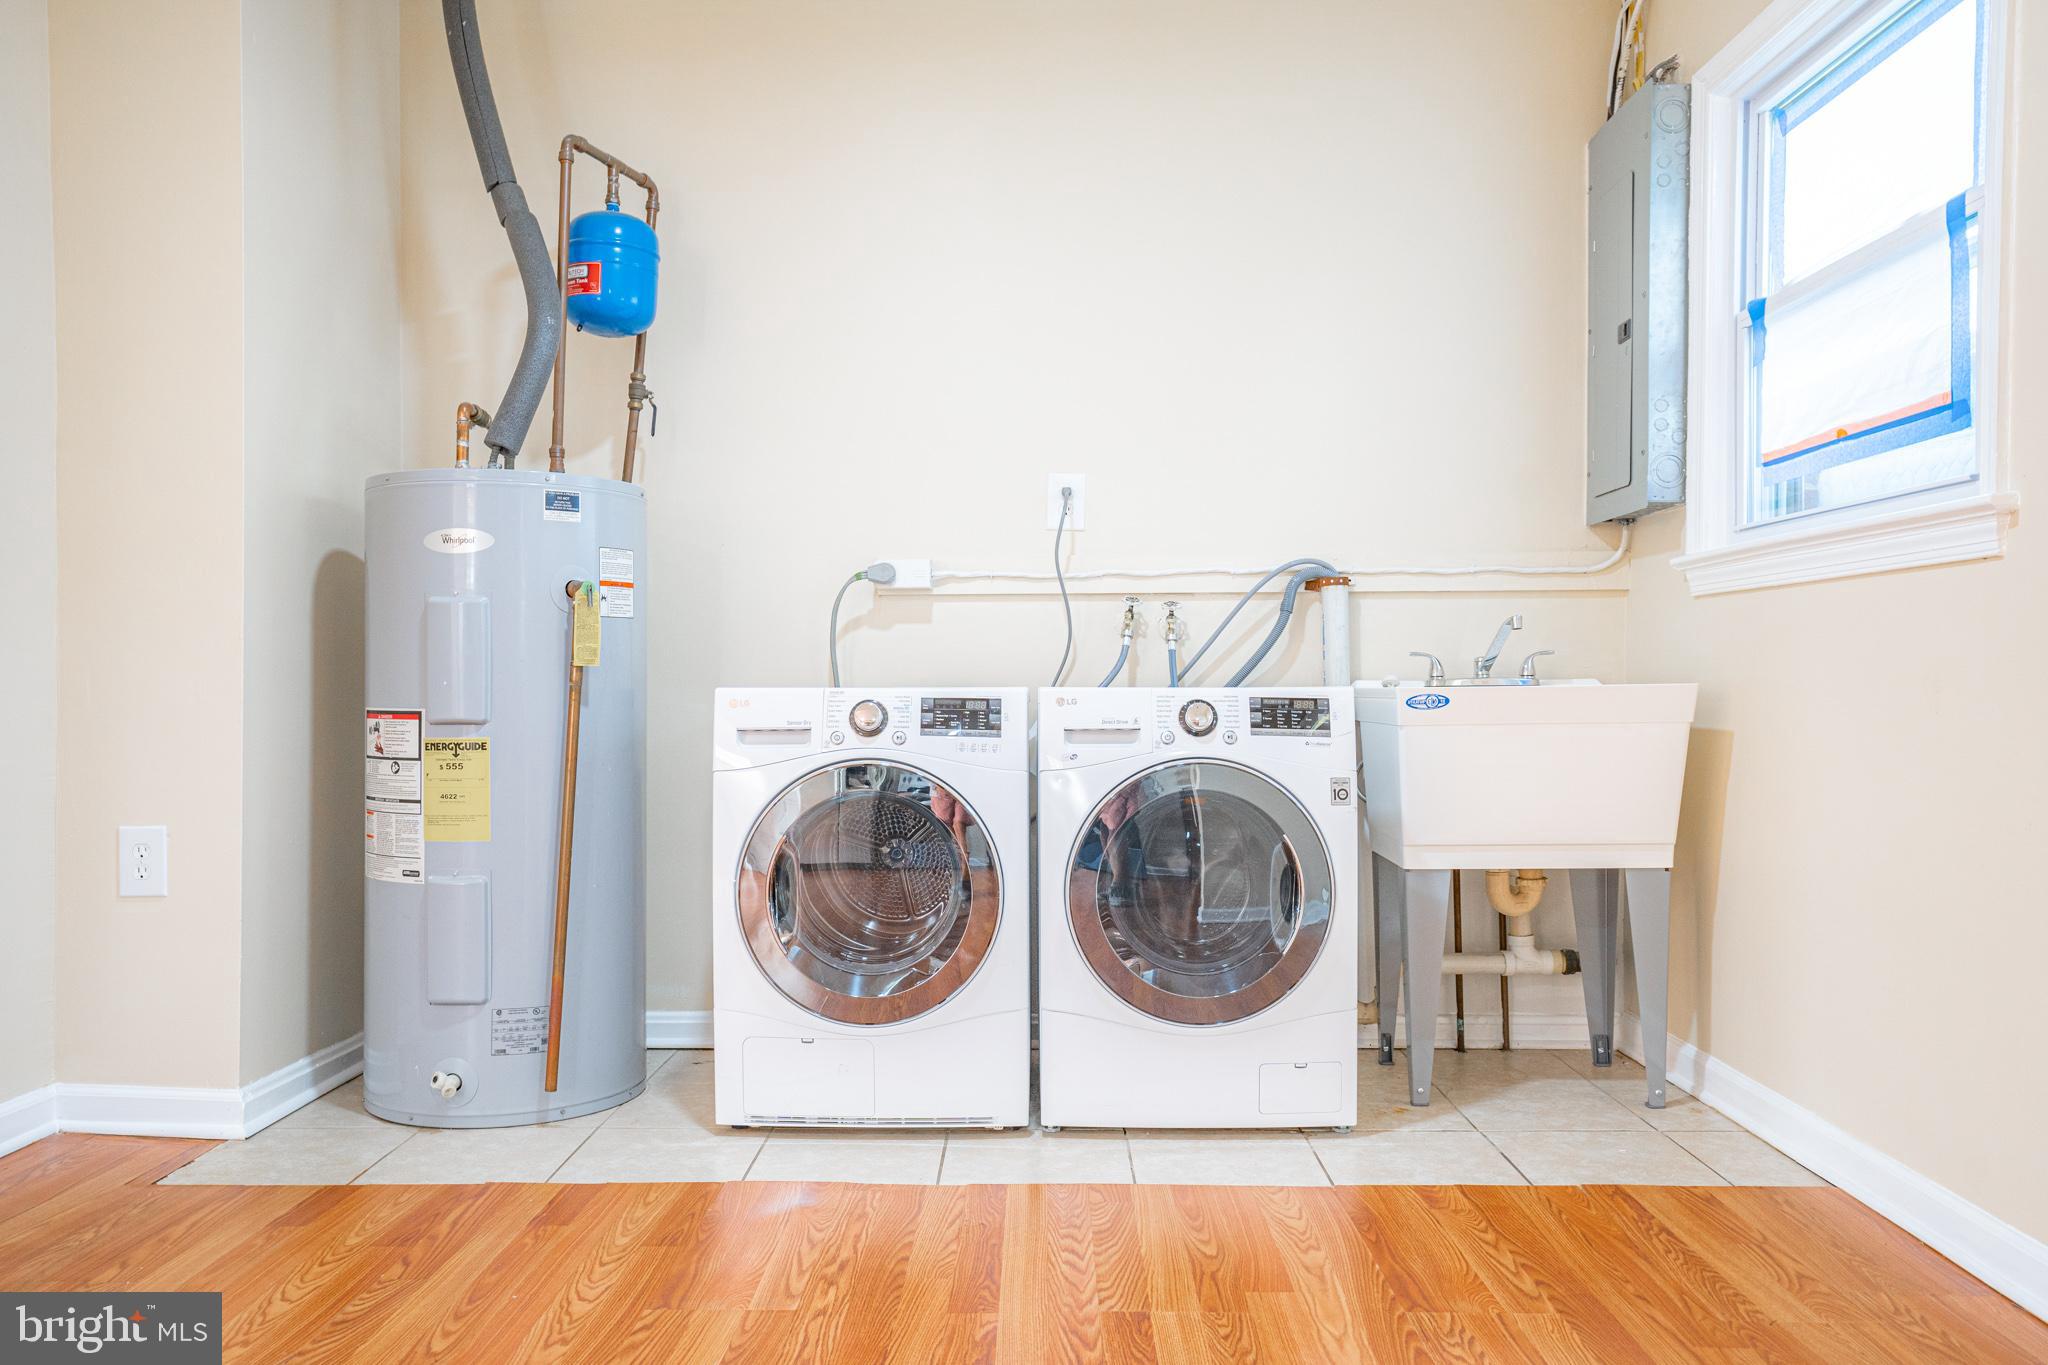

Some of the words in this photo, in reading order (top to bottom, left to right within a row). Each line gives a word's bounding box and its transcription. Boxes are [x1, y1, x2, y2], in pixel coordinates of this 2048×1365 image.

[441, 536, 475, 545] Whirlpool
[1066, 698, 1078, 706] LG
[445, 762, 464, 770] 555
[1333, 788, 1349, 801] 10
